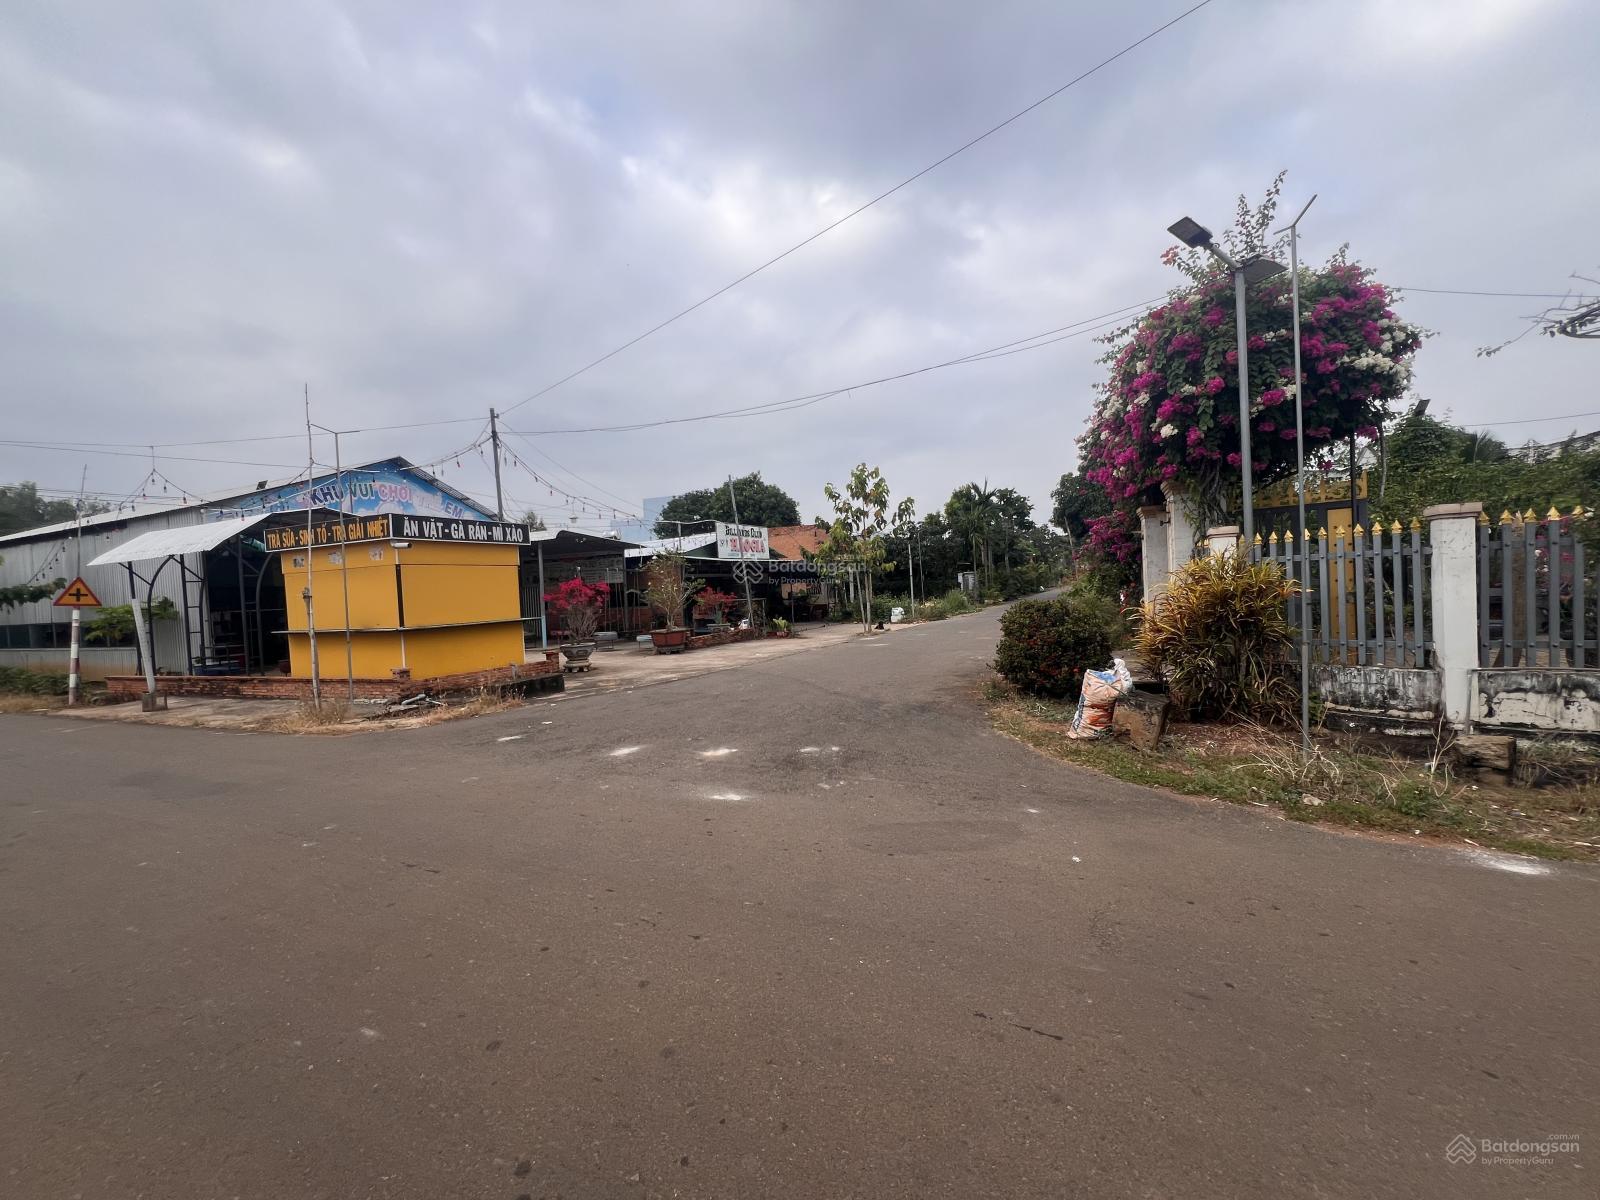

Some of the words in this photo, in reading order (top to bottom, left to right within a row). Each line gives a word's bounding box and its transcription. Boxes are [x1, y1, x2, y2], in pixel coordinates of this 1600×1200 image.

[310, 484, 344, 505] KHU
[349, 483, 375, 500] VUI
[299, 528, 315, 546] SINH
[316, 522, 327, 543] TỐ
[348, 517, 365, 541] GIẢI
[403, 516, 419, 537] ĂN
[451, 521, 466, 540] GÀ
[468, 522, 488, 541] RÁN
[492, 523, 504, 542] MÌ
[505, 524, 523, 543] XÀO
